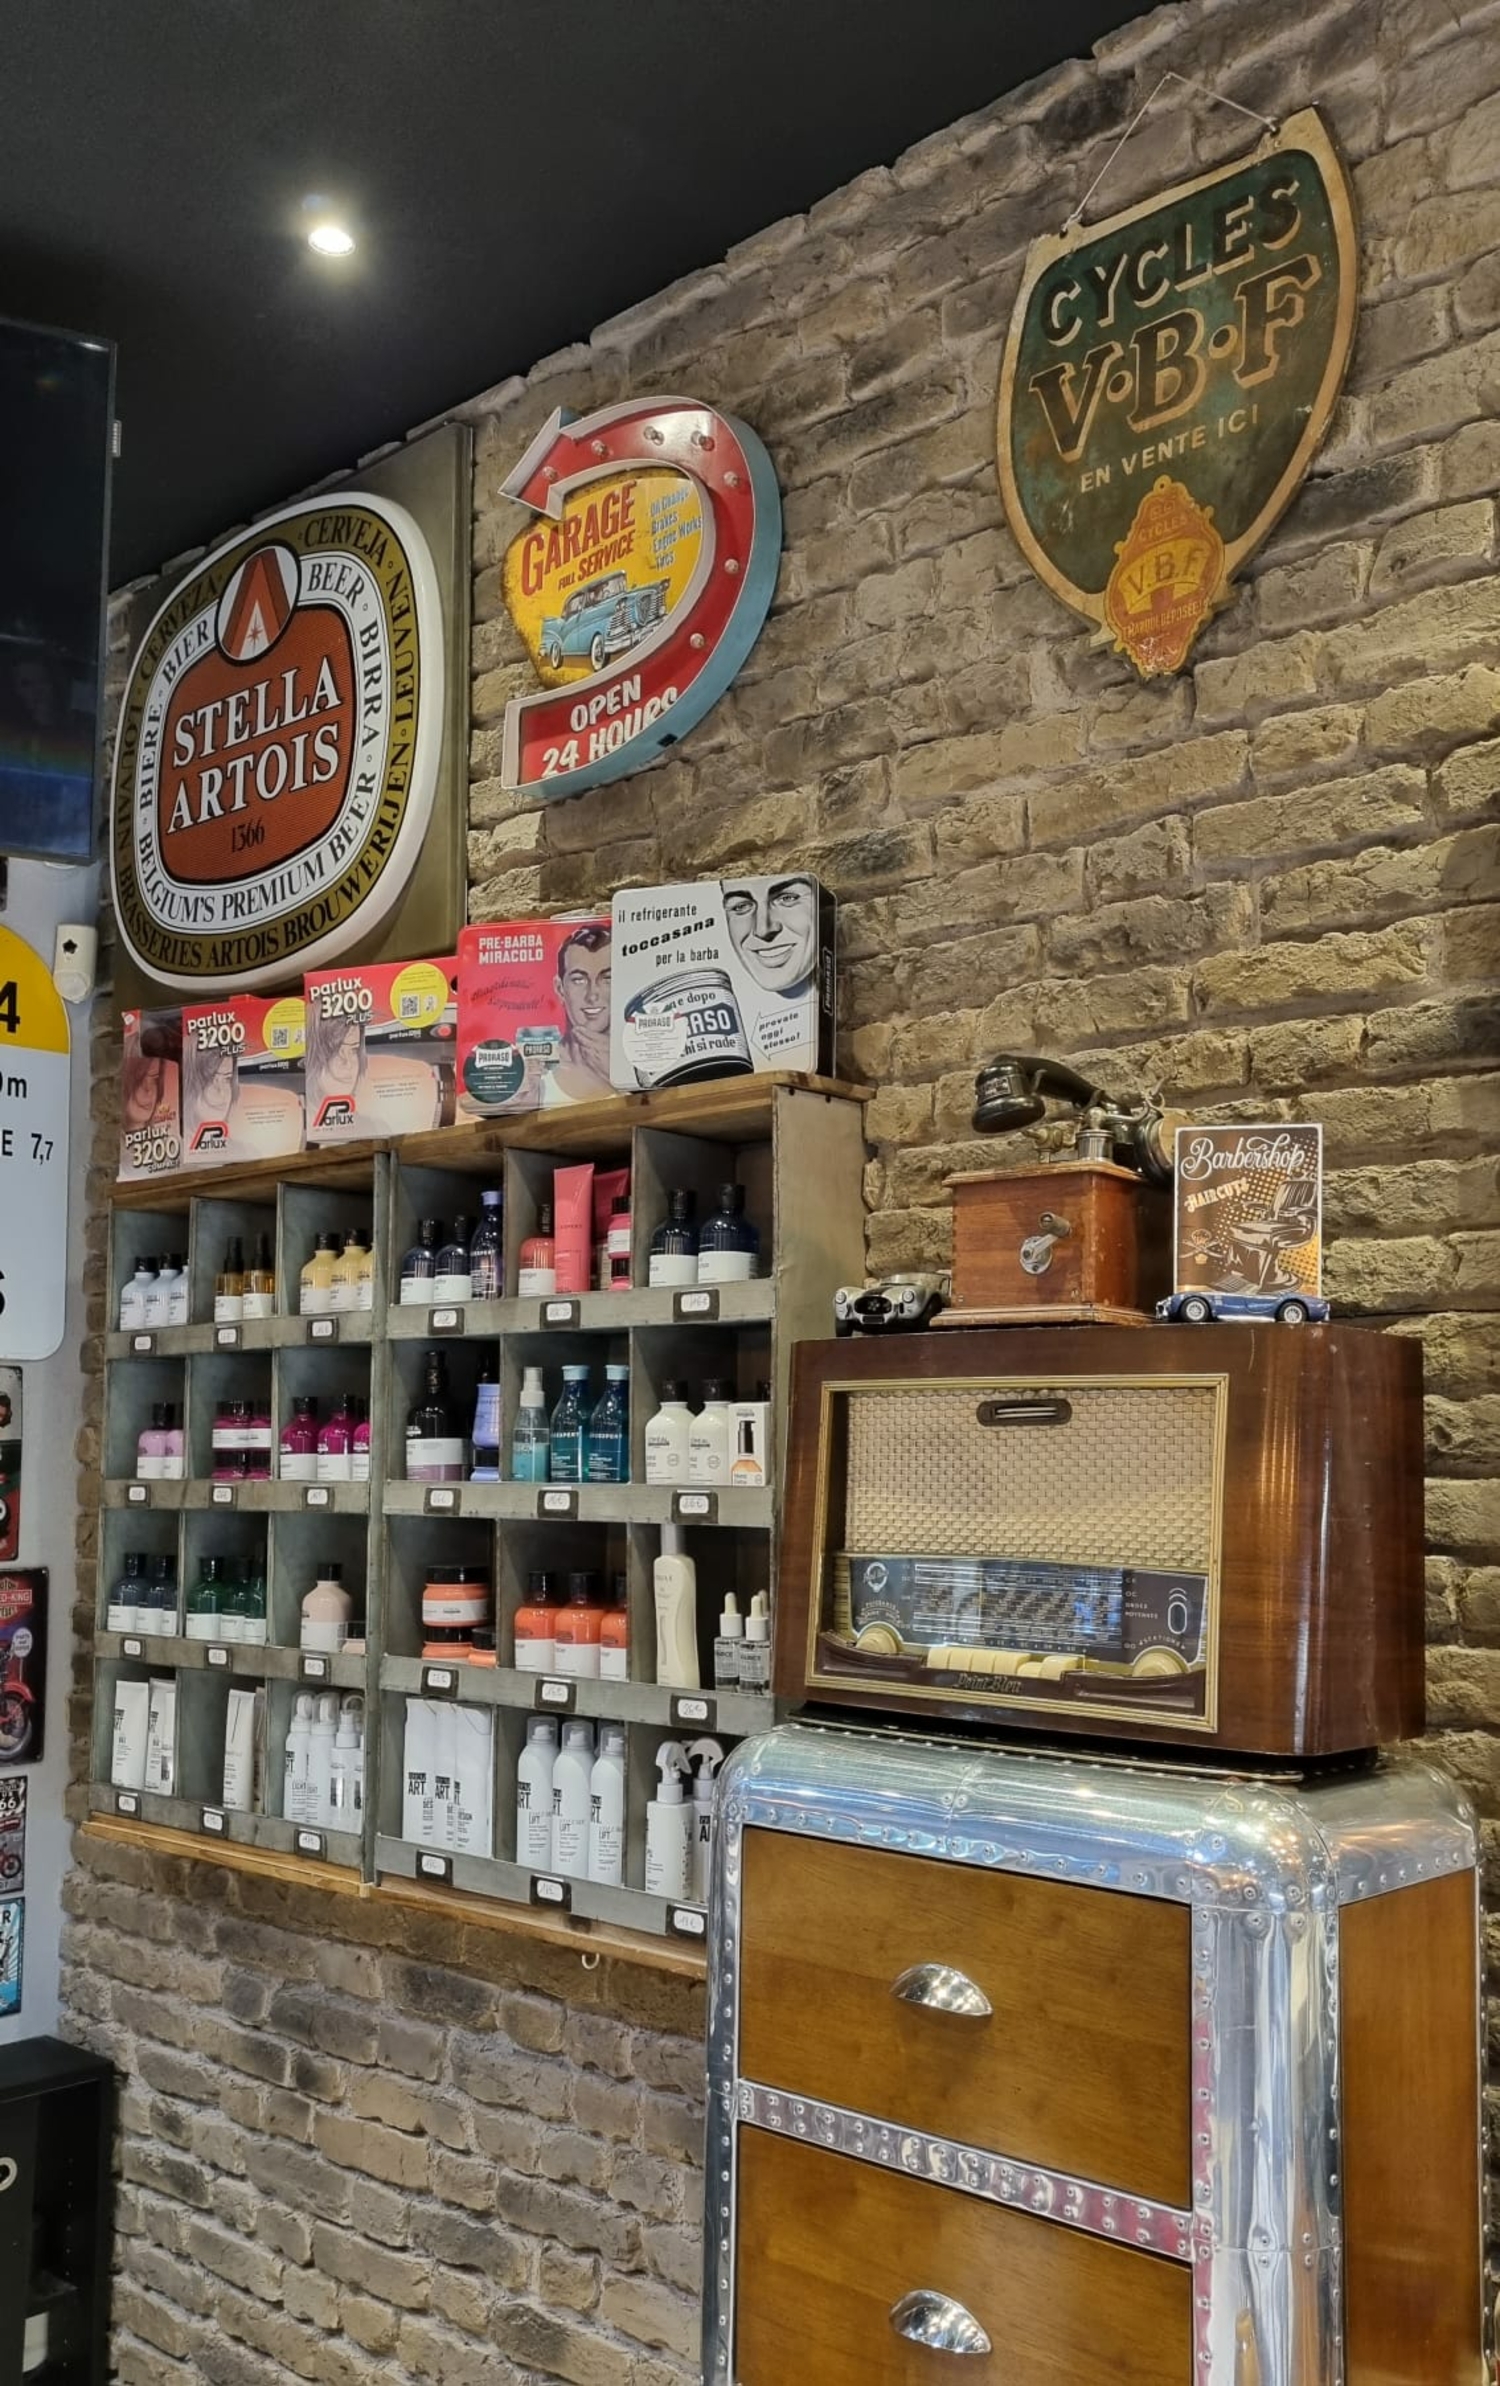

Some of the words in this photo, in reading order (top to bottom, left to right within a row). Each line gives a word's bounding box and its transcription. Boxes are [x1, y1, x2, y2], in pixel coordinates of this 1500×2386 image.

[1043, 177, 1301, 347] CYCLES
[1080, 465, 1111, 493] EN
[1121, 426, 1206, 476] VENTE
[1217, 404, 1258, 438] ICI
[521, 480, 638, 597] GARAGE
[651, 512, 679, 535] Brakes
[1138, 514, 1188, 542] CYCLES
[304, 515, 389, 569] CERVEJA
[558, 572, 577, 591] FULL
[577, 529, 636, 581] SERVICE
[307, 562, 365, 608] BEER
[140, 572, 222, 681] CERVEZA
[161, 618, 210, 686] BIER
[360, 617, 383, 747] BIRRA
[172, 655, 342, 768] STELLA
[570, 674, 641, 732] OPEN
[118, 864, 202, 969] BRASSERIES
[206, 928, 280, 969] ARTOIS
[283, 741, 411, 949] BROUWERIJEN
[385, 568, 416, 723] LEUVEN
[139, 703, 163, 810] BIERE
[541, 740, 579, 779] 24
[117, 705, 143, 852] LOUVAIN
[167, 722, 339, 834] ARTOIS
[139, 832, 215, 923] BELGIUM'S
[221, 851, 326, 922] PREMIUM
[326, 771, 376, 864] BEER
[231, 820, 265, 853] 1366
[618, 909, 625, 923] il
[630, 903, 697, 922] refrigerante
[478, 934, 543, 950] PRE-BARBA
[622, 917, 715, 957] toccasana
[478, 948, 543, 965] MIRACOLO
[656, 953, 672, 968] per
[676, 950, 685, 963] la
[690, 947, 719, 962] barba
[310, 976, 362, 999] parlux
[320, 989, 373, 1019] 3200
[687, 992, 716, 1004] dopo
[187, 1011, 236, 1034] parlux
[346, 1012, 374, 1025] PLUS
[759, 1013, 799, 1031] provate
[198, 1024, 246, 1051] 3200
[219, 1042, 247, 1056] PLUS
[697, 1037, 708, 1052] si
[709, 1037, 736, 1049] rade
[479, 1052, 510, 1063] PRORASO
[133, 1136, 180, 1168] 3200
[1181, 1133, 1305, 1181] Barbershop
[408, 1780, 426, 1796] ART
[435, 1784, 450, 1800] ART
